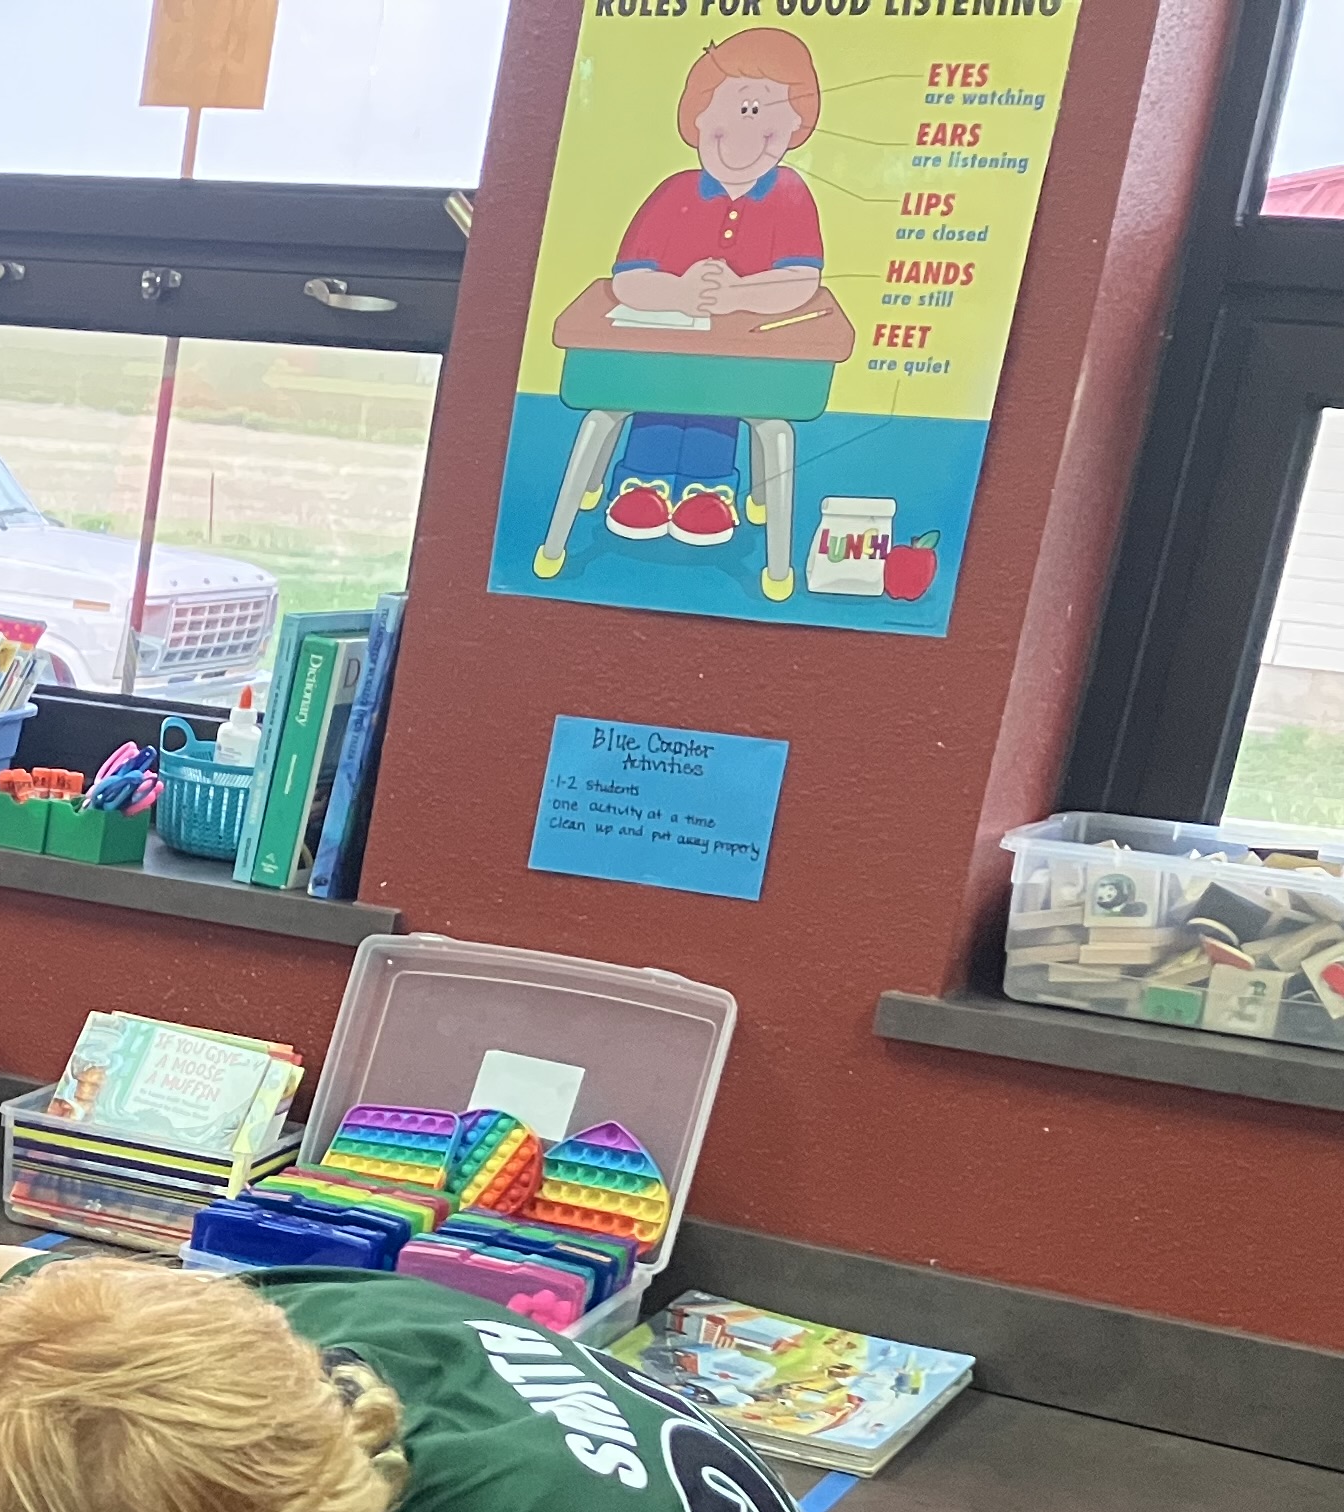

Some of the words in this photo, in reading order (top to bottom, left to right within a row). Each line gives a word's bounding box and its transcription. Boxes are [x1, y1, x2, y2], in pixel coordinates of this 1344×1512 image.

[928, 63, 990, 87] EYES
[925, 92, 955, 105] are
[962, 88, 1046, 111] watching
[916, 123, 982, 147] EARS
[912, 154, 942, 168] are
[948, 151, 1030, 174] listening
[900, 192, 957, 217] LIPS
[896, 228, 925, 240] are
[932, 224, 989, 242] closed
[886, 260, 976, 286] HANDS
[881, 293, 912, 306] are
[917, 291, 954, 307] still
[872, 323, 932, 349] FEET
[868, 359, 898, 371] are
[903, 356, 951, 377] quiet
[818, 528, 890, 563] LUNCH
[294, 652, 324, 728] Dictionary
[593, 727, 641, 751] Blue
[648, 732, 715, 758] Counter
[622, 754, 704, 777] Activities
[586, 779, 640, 797] students
[552, 799, 579, 812] one
[589, 800, 642, 820] activity
[647, 809, 662, 821] at
[671, 813, 679, 824] a
[684, 814, 716, 829] time
[549, 816, 586, 832] clean
[595, 823, 614, 836] up
[618, 825, 644, 838] and
[652, 831, 672, 843] put
[677, 836, 709, 855] away
[714, 840, 761, 862] properly
[155, 1033, 173, 1050] IF
[176, 1037, 204, 1056] YOU
[205, 1045, 245, 1067] GIVE
[155, 1054, 169, 1069] A
[172, 1056, 226, 1083] MOOSE
[145, 1071, 158, 1085] A
[161, 1074, 221, 1103] MUFFIN
[462, 1318, 649, 1490] SMITH
